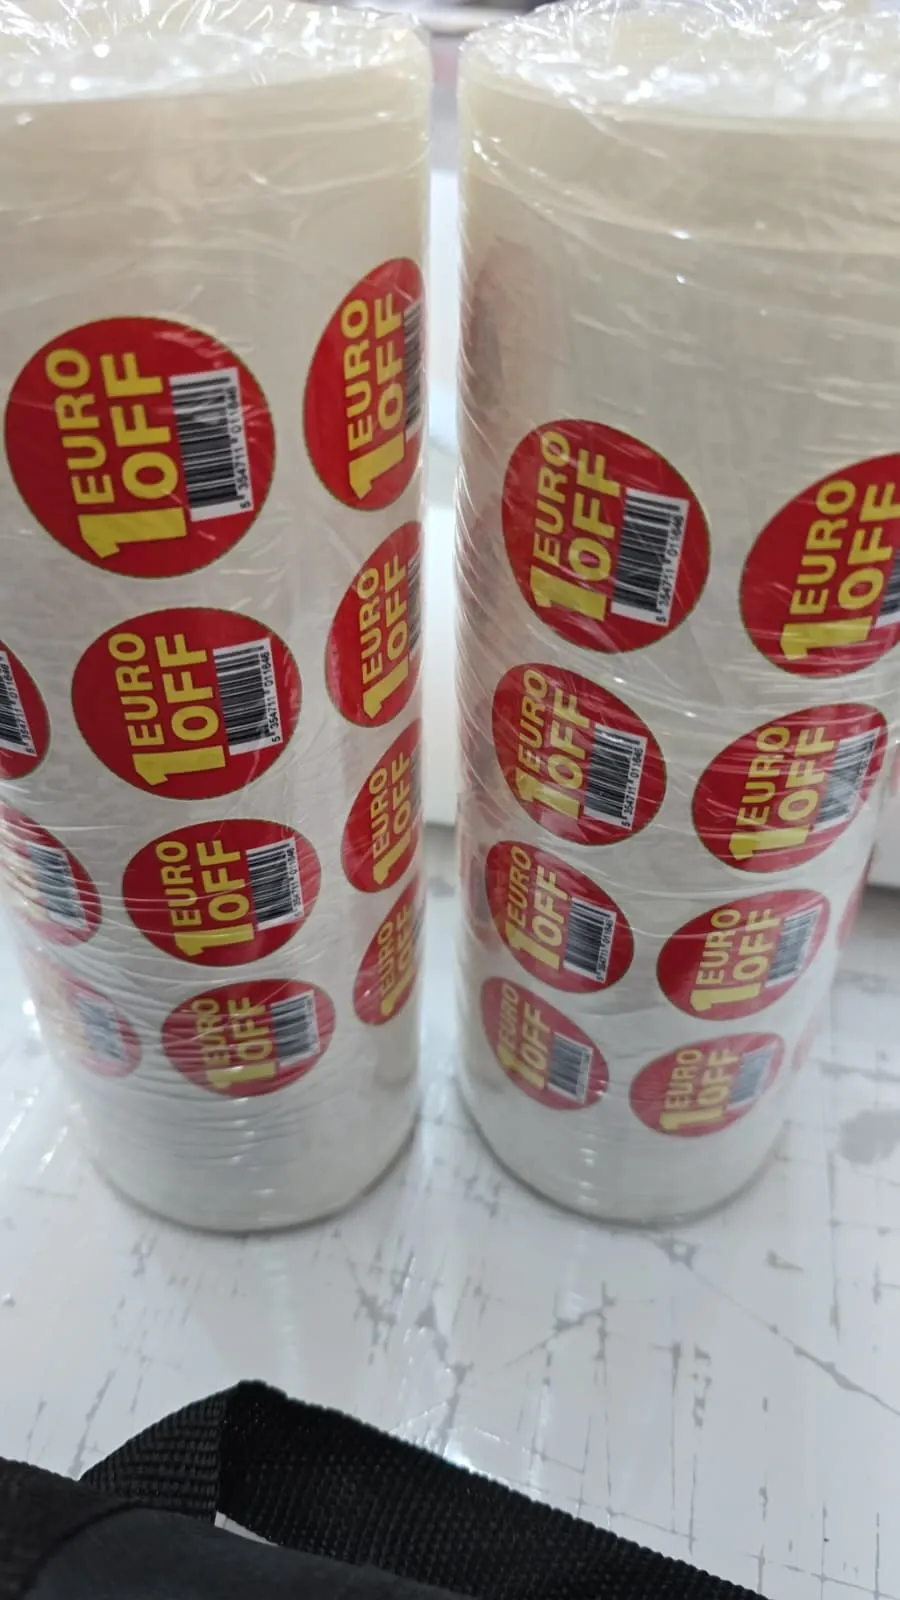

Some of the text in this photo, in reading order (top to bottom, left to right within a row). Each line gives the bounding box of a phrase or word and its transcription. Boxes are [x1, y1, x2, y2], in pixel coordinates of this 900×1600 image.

[340, 299, 405, 500] 1 EURO
[374, 293, 404, 430] OFF
[45, 348, 187, 559] 1 EURO
[100, 353, 178, 499] OFF
[231, 447, 249, 494] 354711
[530, 431, 607, 621] 1 EURO
[568, 448, 621, 581] OFF
[837, 482, 900, 610] OFF
[384, 555, 408, 661] OFF
[779, 479, 873, 661] 1 EURO
[154, 634, 219, 741] OFF
[261, 652, 273, 688] 011646
[357, 567, 408, 719] 1 EURO
[108, 632, 226, 785] 1 EURO
[268, 695, 280, 729] 354711
[515, 669, 580, 820] 1 EURO
[547, 688, 590, 790] OFF
[369, 768, 411, 884] 1 EURO
[392, 752, 411, 834] OFF
[729, 726, 810, 861] 1 EURO
[778, 727, 835, 821] OFF
[156, 840, 254, 956] 1 EURO
[196, 840, 249, 921] OFF
[505, 846, 560, 970] 1 EURO
[532, 865, 568, 947] OFF
[690, 909, 761, 1012] 1 EURO
[733, 908, 781, 981] OFF
[191, 998, 276, 1089] 1 EURO
[228, 997, 272, 1061] OFF
[522, 1001, 550, 1070] OFF
[697, 1049, 739, 1105] OFF
[659, 1049, 723, 1130] 1 EURO
